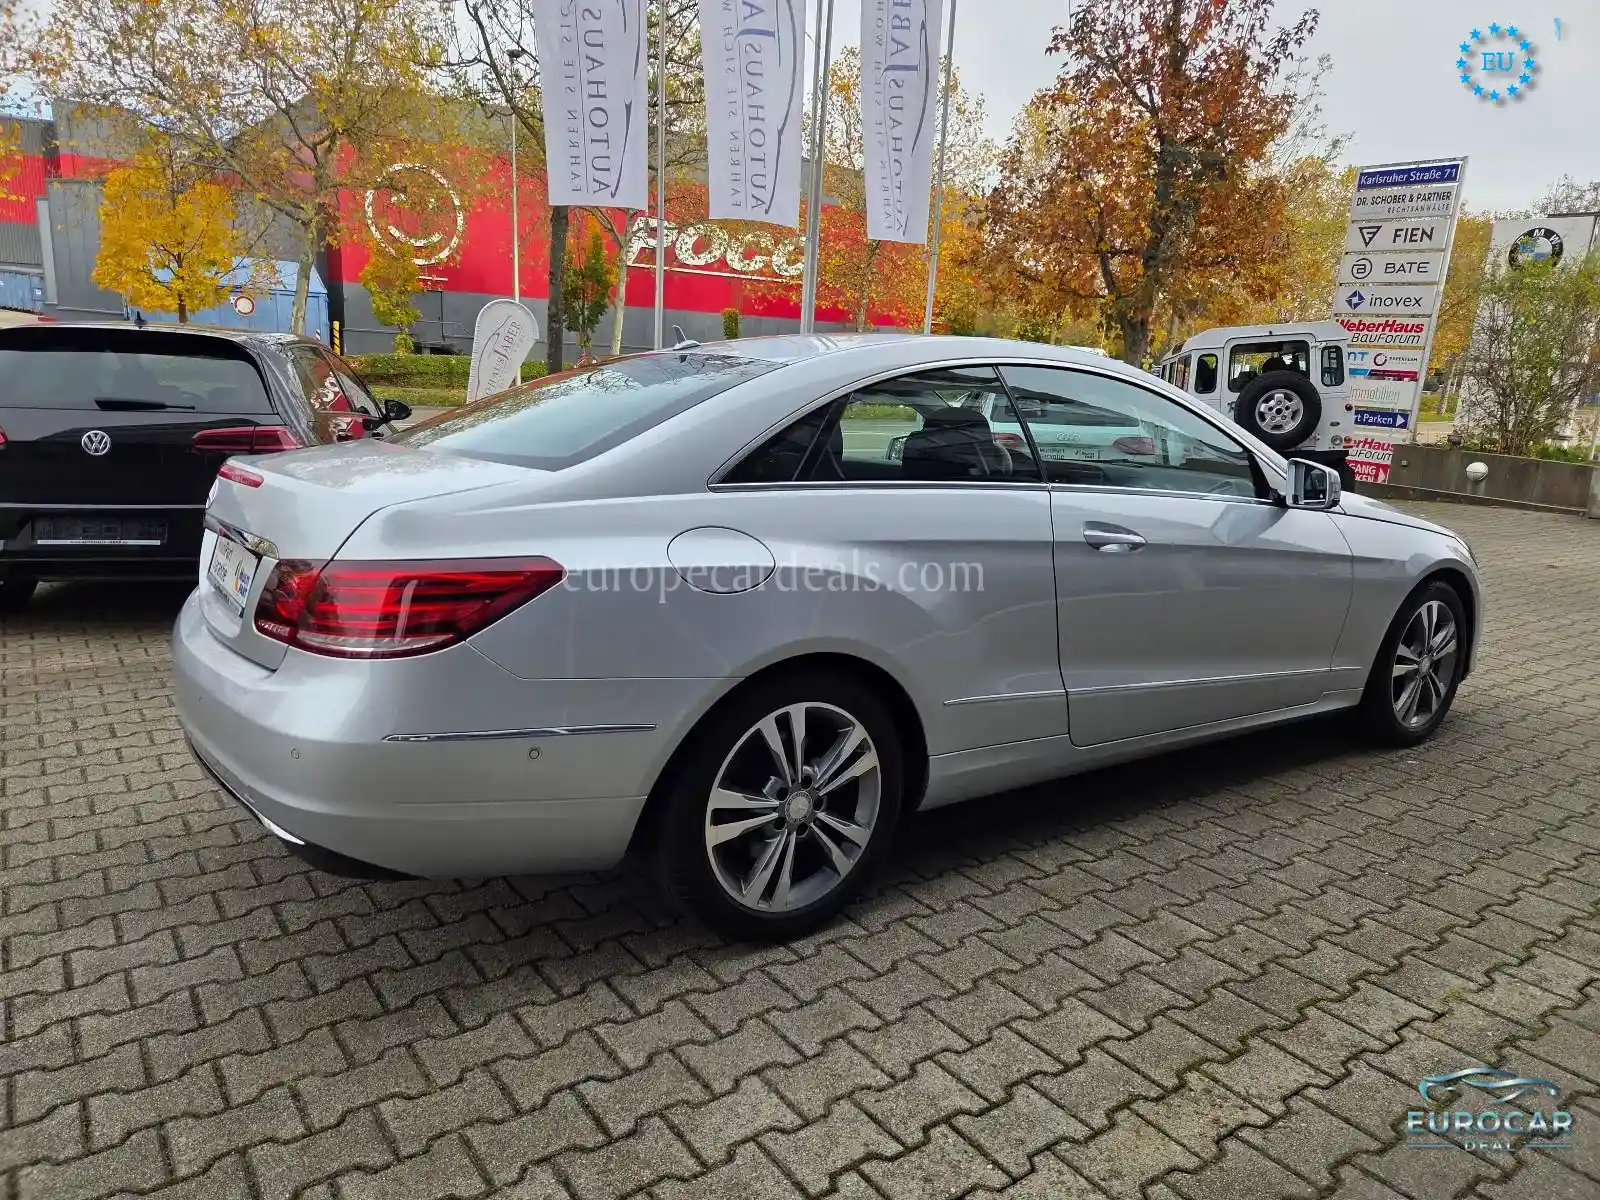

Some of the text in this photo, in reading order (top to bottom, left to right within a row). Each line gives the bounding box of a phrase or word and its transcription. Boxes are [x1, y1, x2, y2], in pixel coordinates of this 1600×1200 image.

[1360, 168, 1456, 185] Karlsruher Straße 71
[1356, 191, 1452, 207] DR. SCHOBER & PARTNER
[1392, 226, 1435, 244] FIEN
[1384, 261, 1430, 274] BATE
[1369, 293, 1423, 308] inovex
[1351, 333, 1420, 345] BauForum
[482, 356, 505, 397] OHAUS
[1350, 385, 1400, 401] Immobilien
[1363, 413, 1393, 424] Parken
